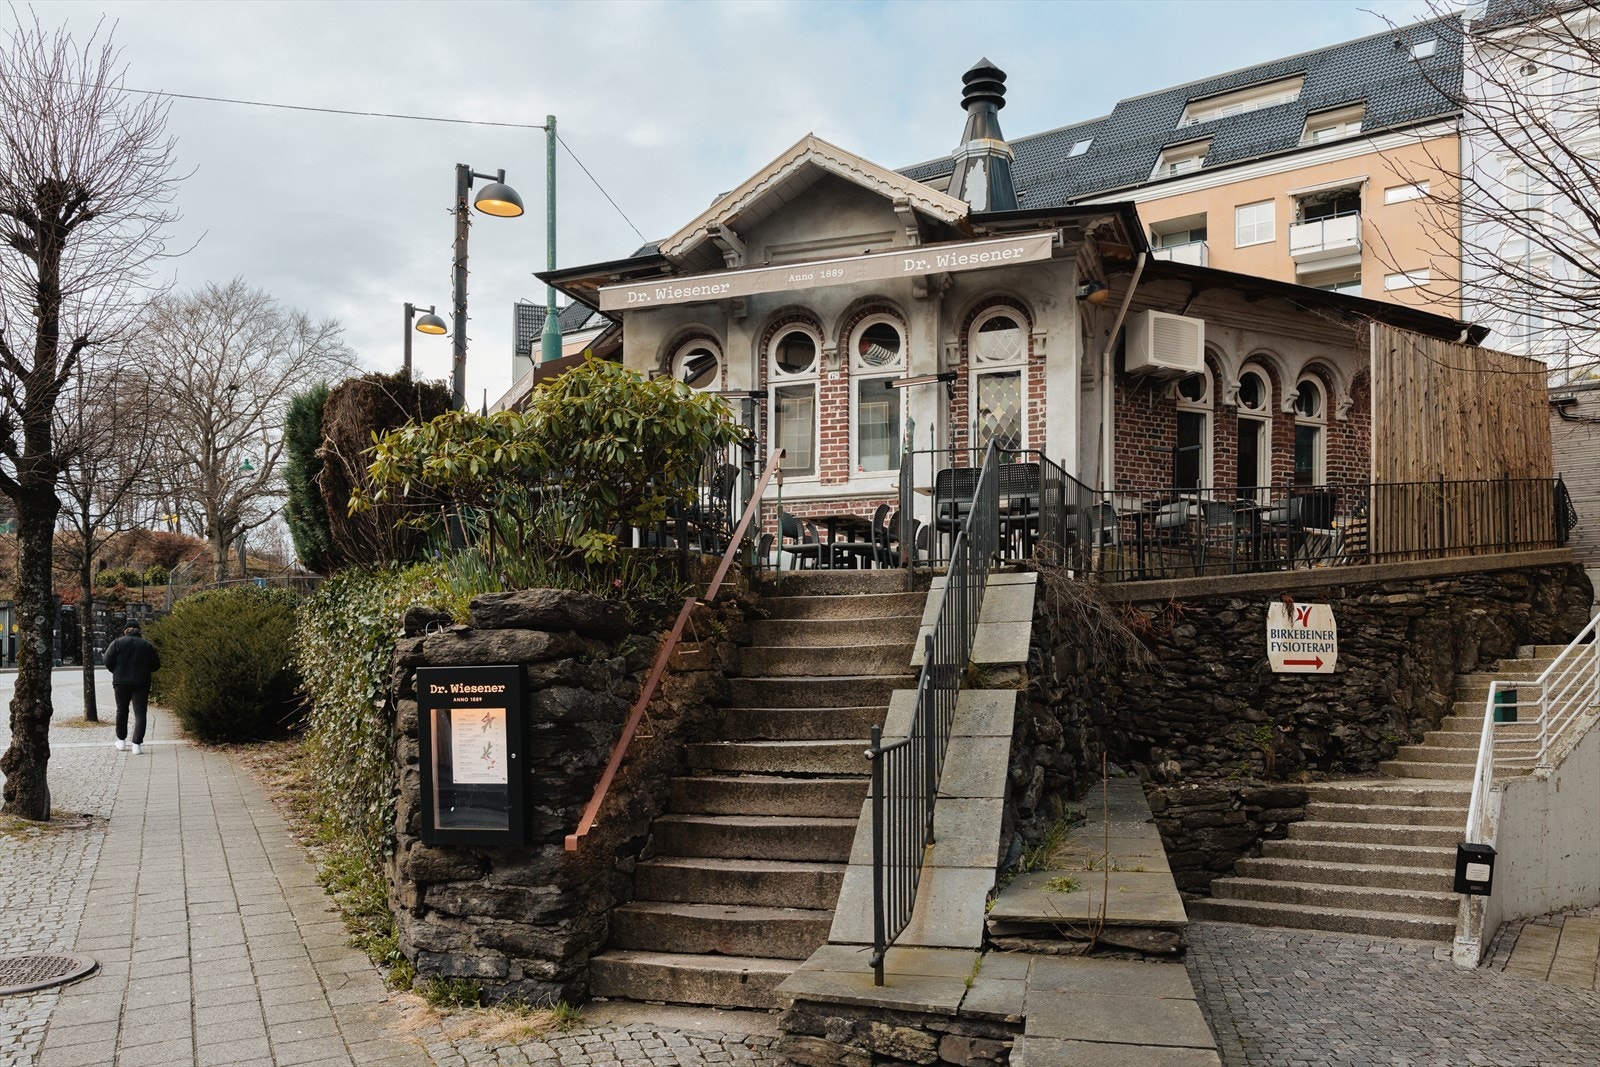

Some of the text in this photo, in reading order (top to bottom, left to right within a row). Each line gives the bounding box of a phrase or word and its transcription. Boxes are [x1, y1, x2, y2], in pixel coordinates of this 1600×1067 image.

[903, 247, 1024, 272] Dr. Wiesener
[788, 268, 844, 282] Anno 1889
[627, 283, 730, 303] Dr. Wiesener
[1270, 628, 1335, 641] BIRKEBEINER
[1271, 641, 1334, 653] FYSIOTERAPI
[430, 682, 506, 694] Dr. Wiesener
